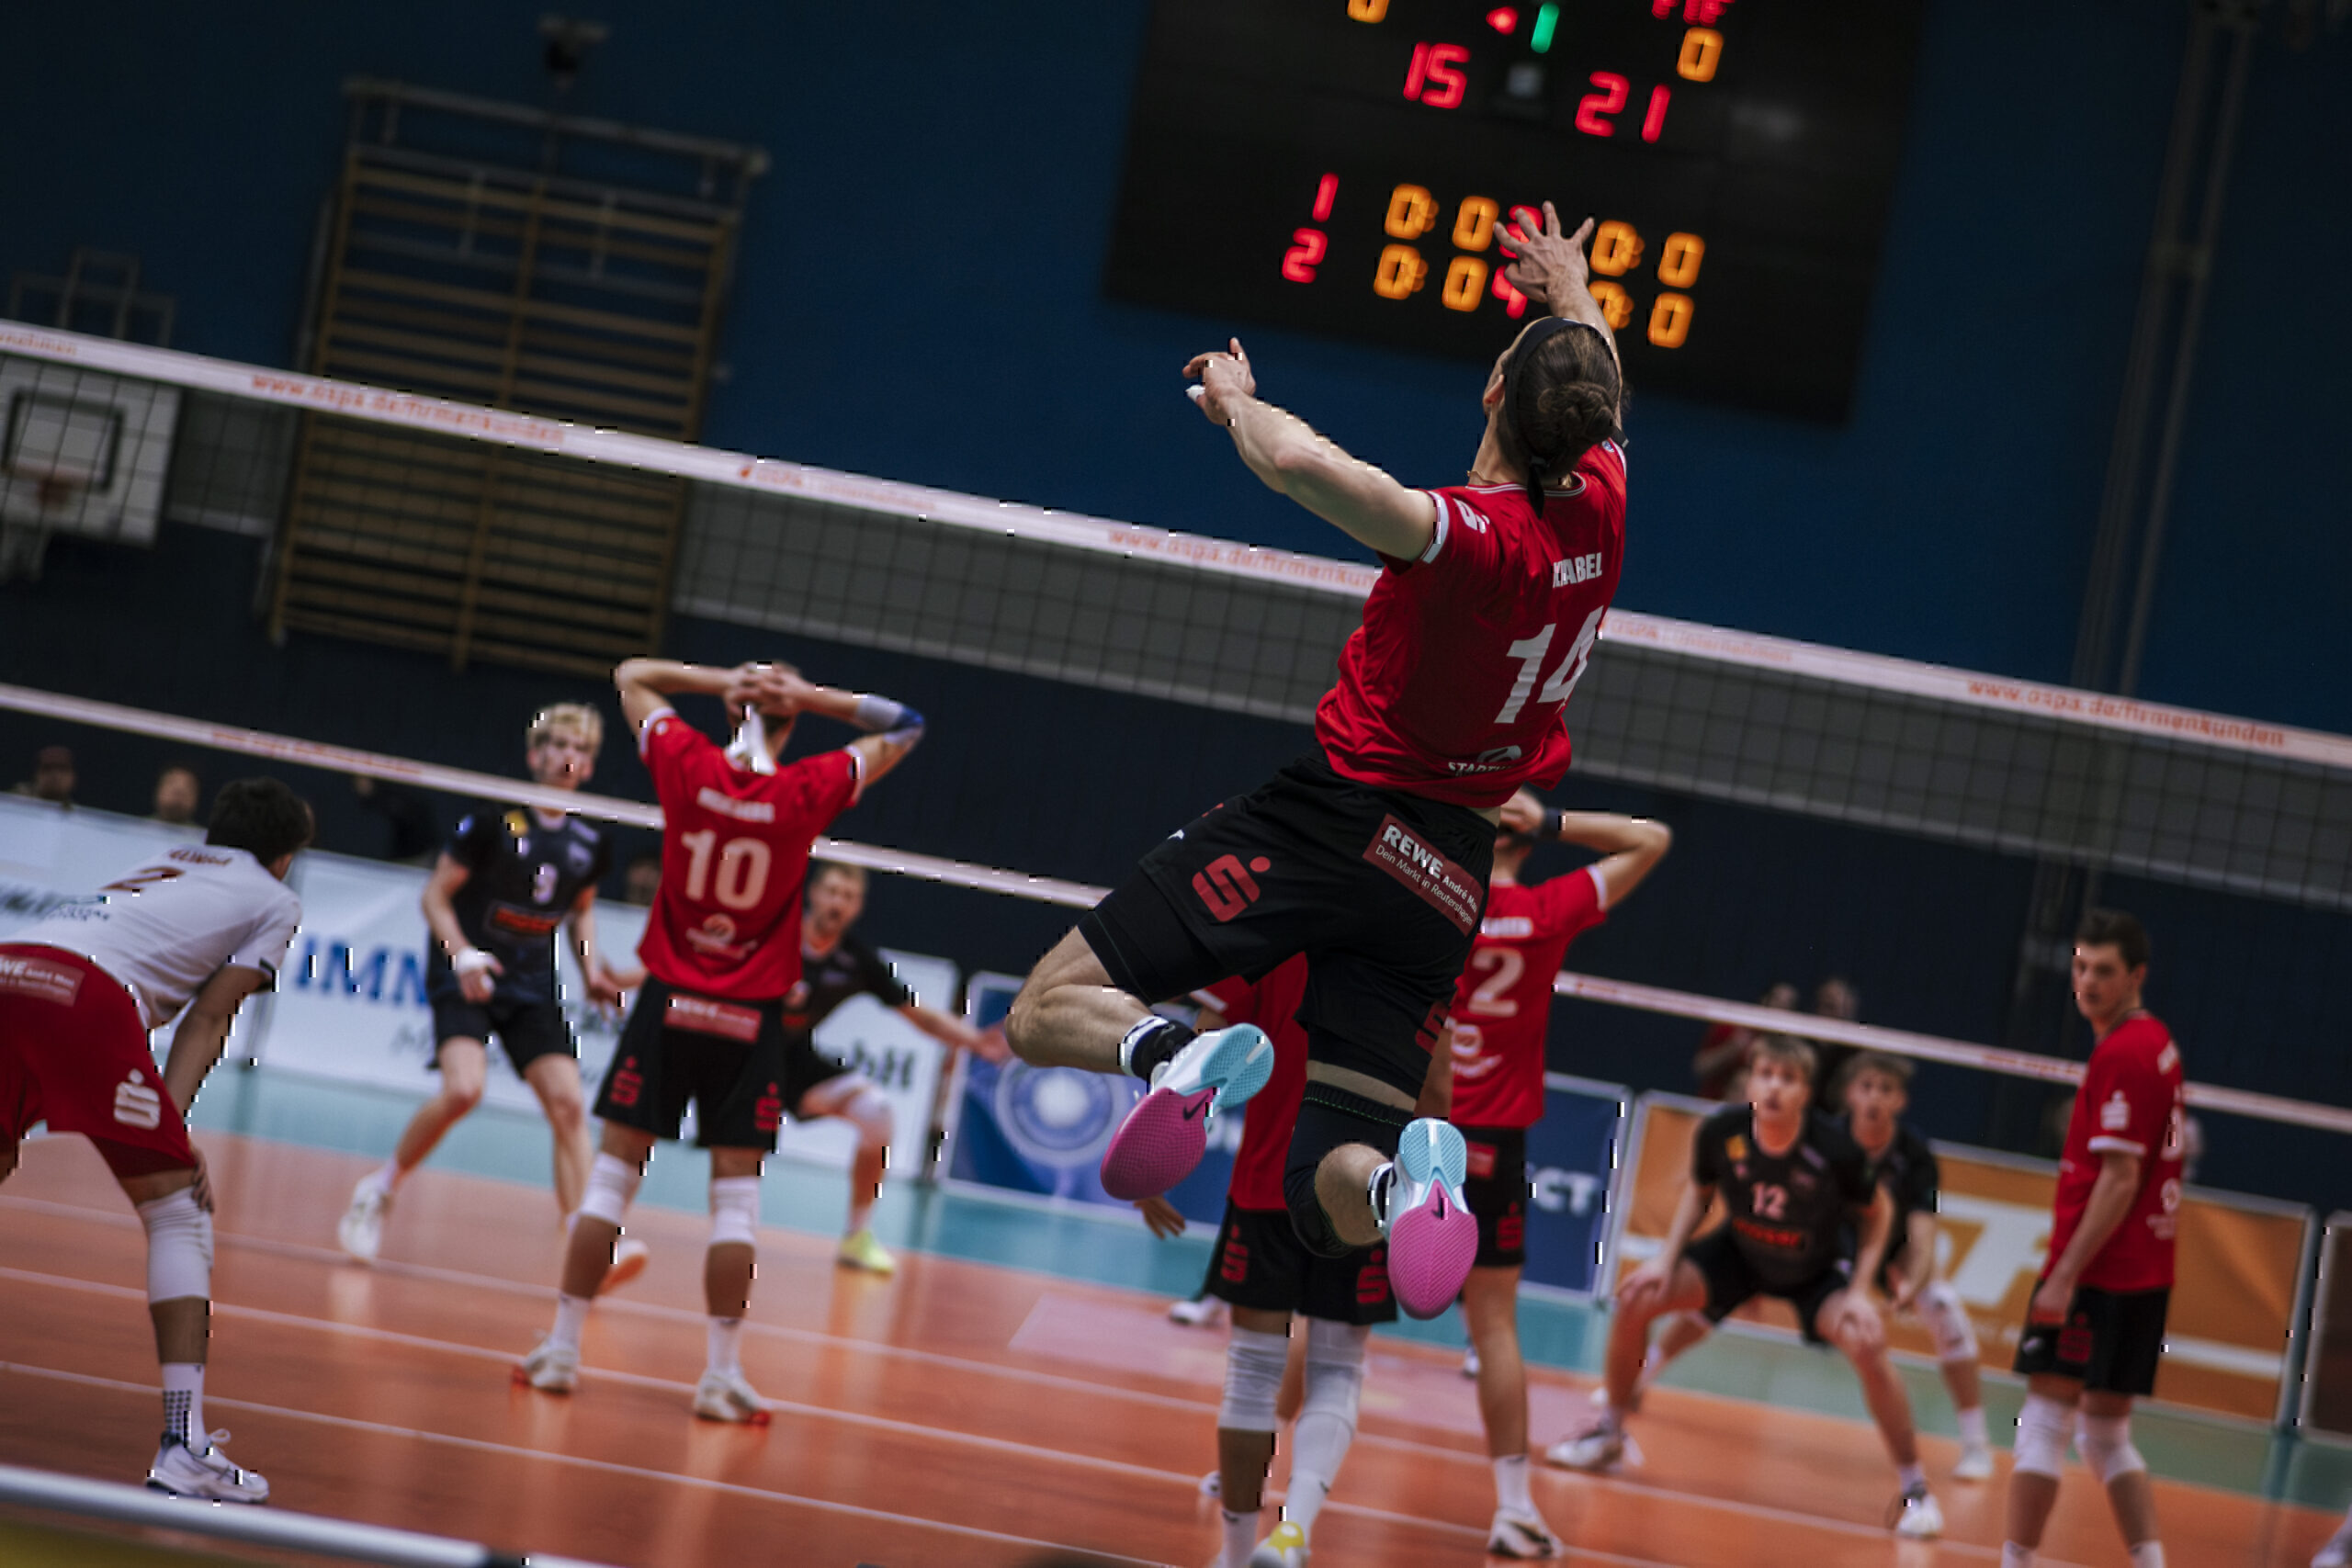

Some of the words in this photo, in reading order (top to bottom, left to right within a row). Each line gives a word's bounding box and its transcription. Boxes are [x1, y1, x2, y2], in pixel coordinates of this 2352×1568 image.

[1404, 41, 1471, 109] 15
[1575, 71, 1671, 144] 21
[1312, 172, 1340, 222] 1
[1282, 227, 1329, 284] 2
[1494, 605, 1604, 723] 14
[681, 829, 771, 909] 10
[1375, 844, 1396, 863] Dein
[1396, 859, 1421, 883] Markt
[1421, 878, 1430, 889] in
[1430, 884, 1473, 926] Reutershagen
[1382, 824, 1443, 879] REWE
[1442, 875, 1468, 900] André
[1467, 946, 1525, 1018] 2
[1751, 1180, 1787, 1221] 12
